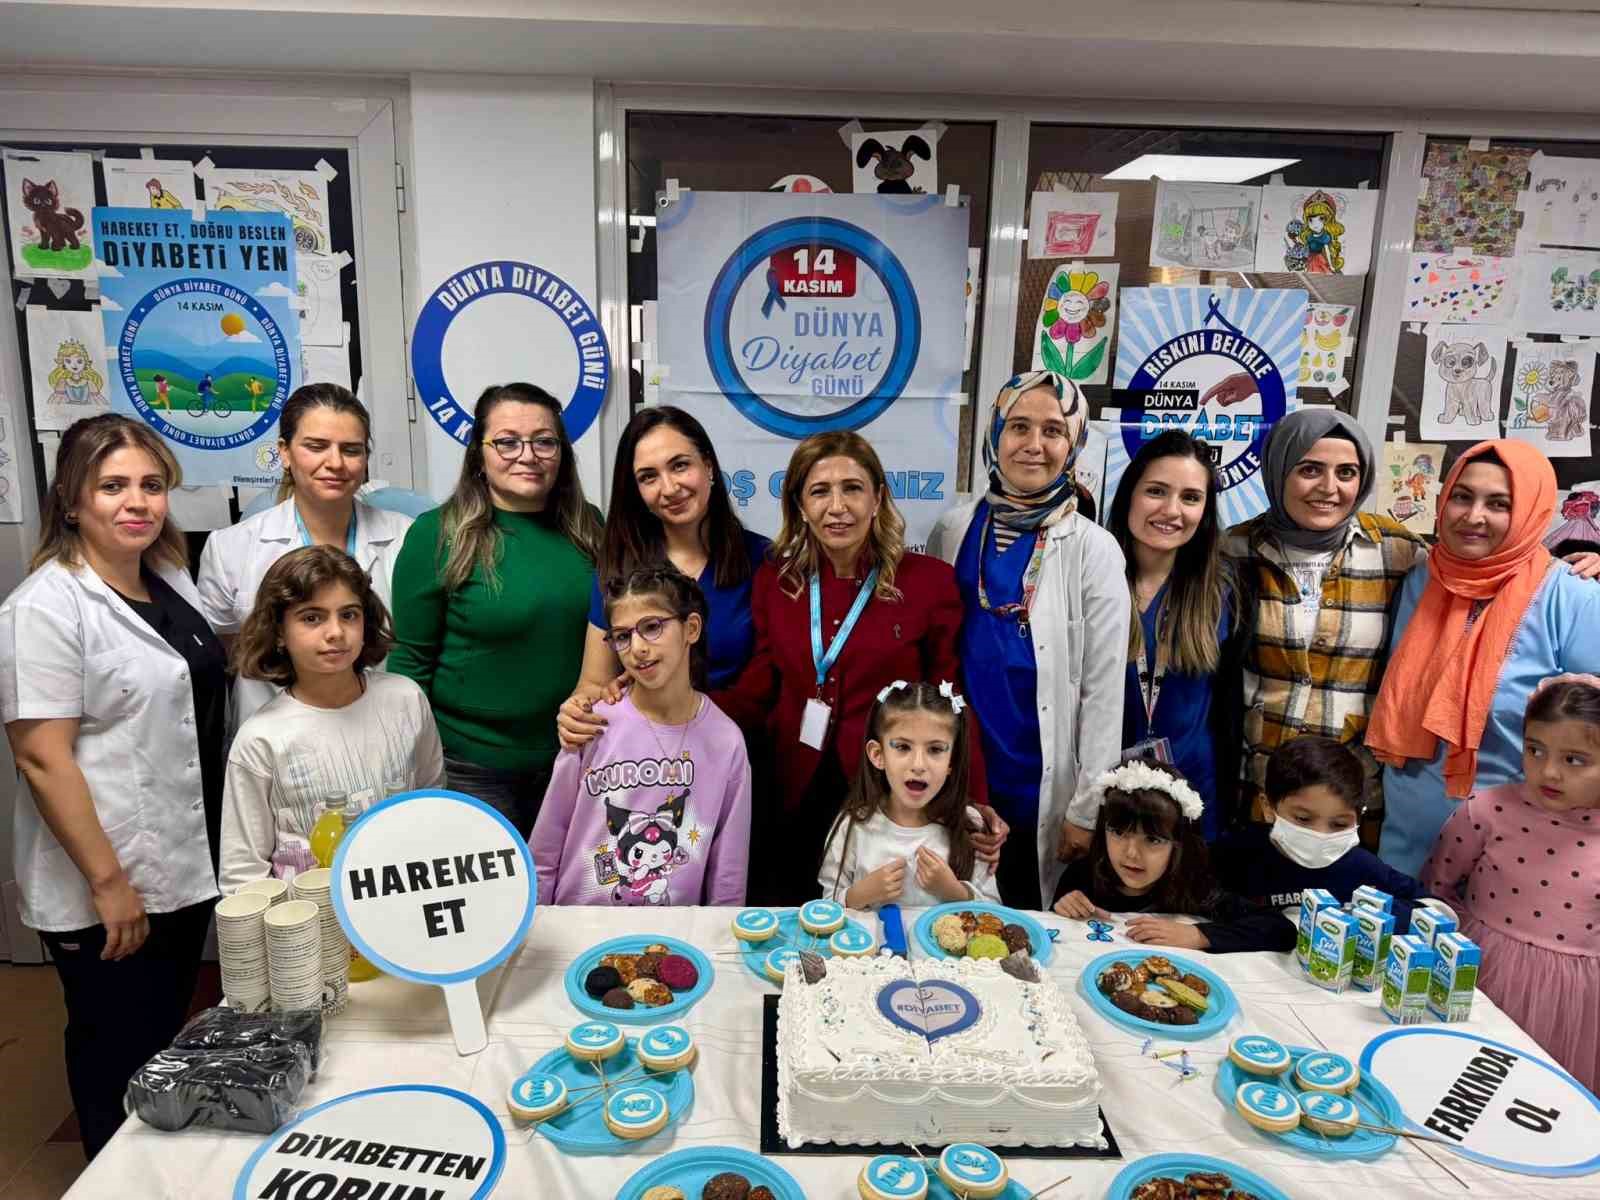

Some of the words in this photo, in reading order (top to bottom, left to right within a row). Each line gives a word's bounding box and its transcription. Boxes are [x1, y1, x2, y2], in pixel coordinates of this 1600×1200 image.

[101, 221, 158, 238] HAREKET
[191, 220, 233, 240] DOĞRU
[239, 225, 286, 241] BESLEN
[239, 245, 288, 271] YEN
[793, 248, 836, 275] 14
[153, 285, 182, 302] DÜNYA
[224, 285, 249, 306] GÜNÜ
[783, 279, 843, 294] KASIM
[177, 302, 190, 312] 14
[191, 302, 224, 312] KASIM
[437, 266, 504, 312] DÜNYA
[578, 330, 605, 390] GÜNÜ
[794, 306, 884, 338] DÜNYA
[741, 336, 882, 384] Diyabet
[811, 374, 864, 396] GÜNÜ
[1159, 380, 1168, 389] 14
[1170, 380, 1196, 389] KASIM
[429, 396, 457, 425] 14
[1144, 392, 1194, 408] DÜNYA
[586, 758, 695, 796] KUROMI
[348, 848, 517, 900] HAREKET
[422, 898, 467, 939] ET
[1424, 1046, 1519, 1142] FARKINDA
[1505, 1098, 1561, 1134] OL
